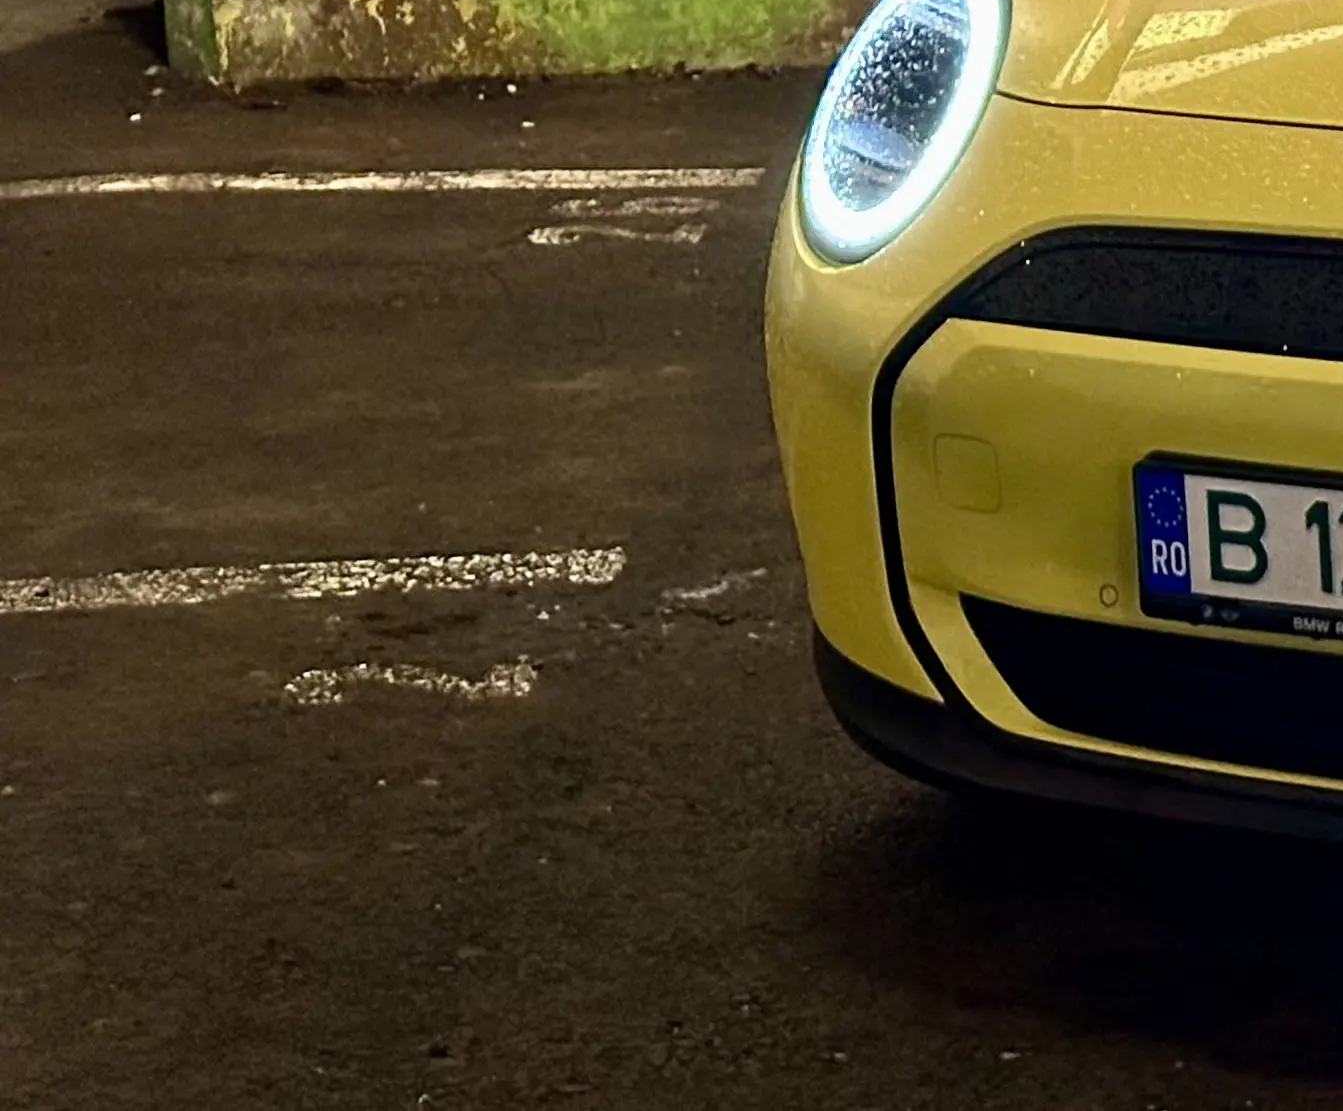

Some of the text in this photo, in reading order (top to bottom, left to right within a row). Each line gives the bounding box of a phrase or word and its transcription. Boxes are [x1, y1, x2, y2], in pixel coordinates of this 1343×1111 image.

[1206, 489, 1269, 585] B
[1152, 539, 1187, 578] RO
[1293, 616, 1330, 633] BMW
